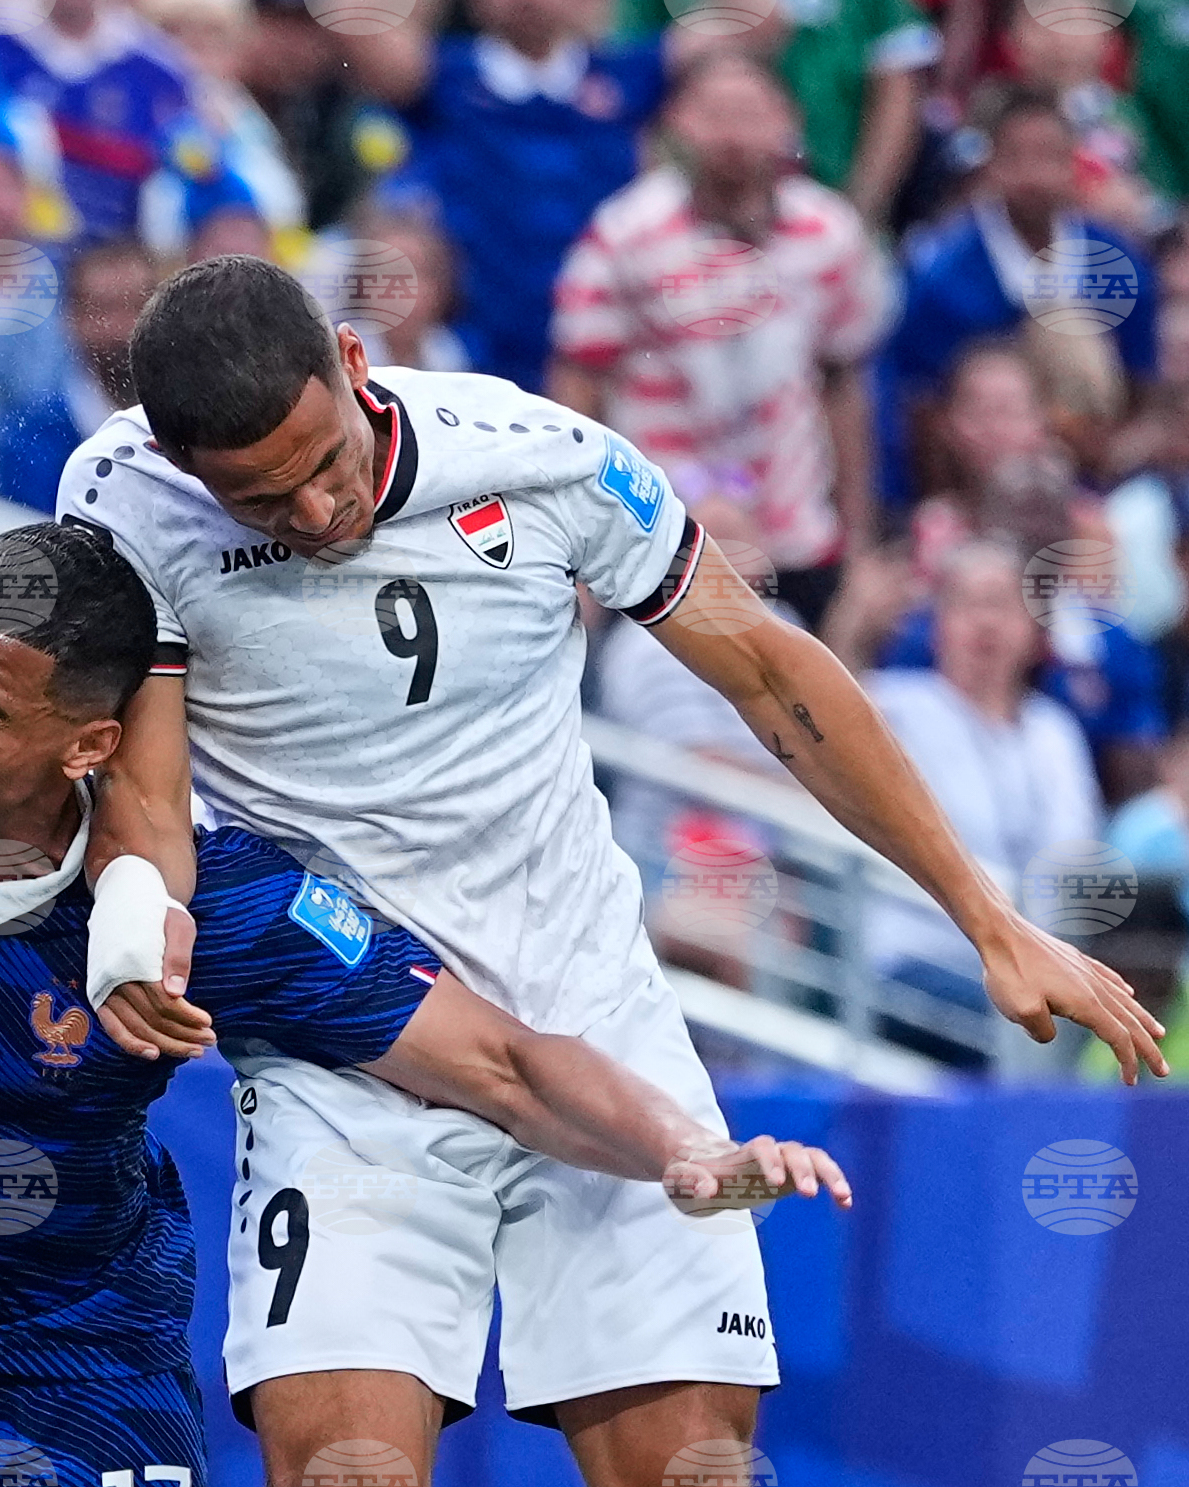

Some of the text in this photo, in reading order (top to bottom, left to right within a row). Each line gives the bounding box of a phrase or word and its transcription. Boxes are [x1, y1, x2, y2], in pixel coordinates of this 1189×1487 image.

[457, 495, 489, 512] IRAQ
[220, 541, 291, 574] JAKO
[374, 578, 439, 706] 9
[258, 1187, 310, 1328] 9
[717, 1311, 766, 1340] JAKO
